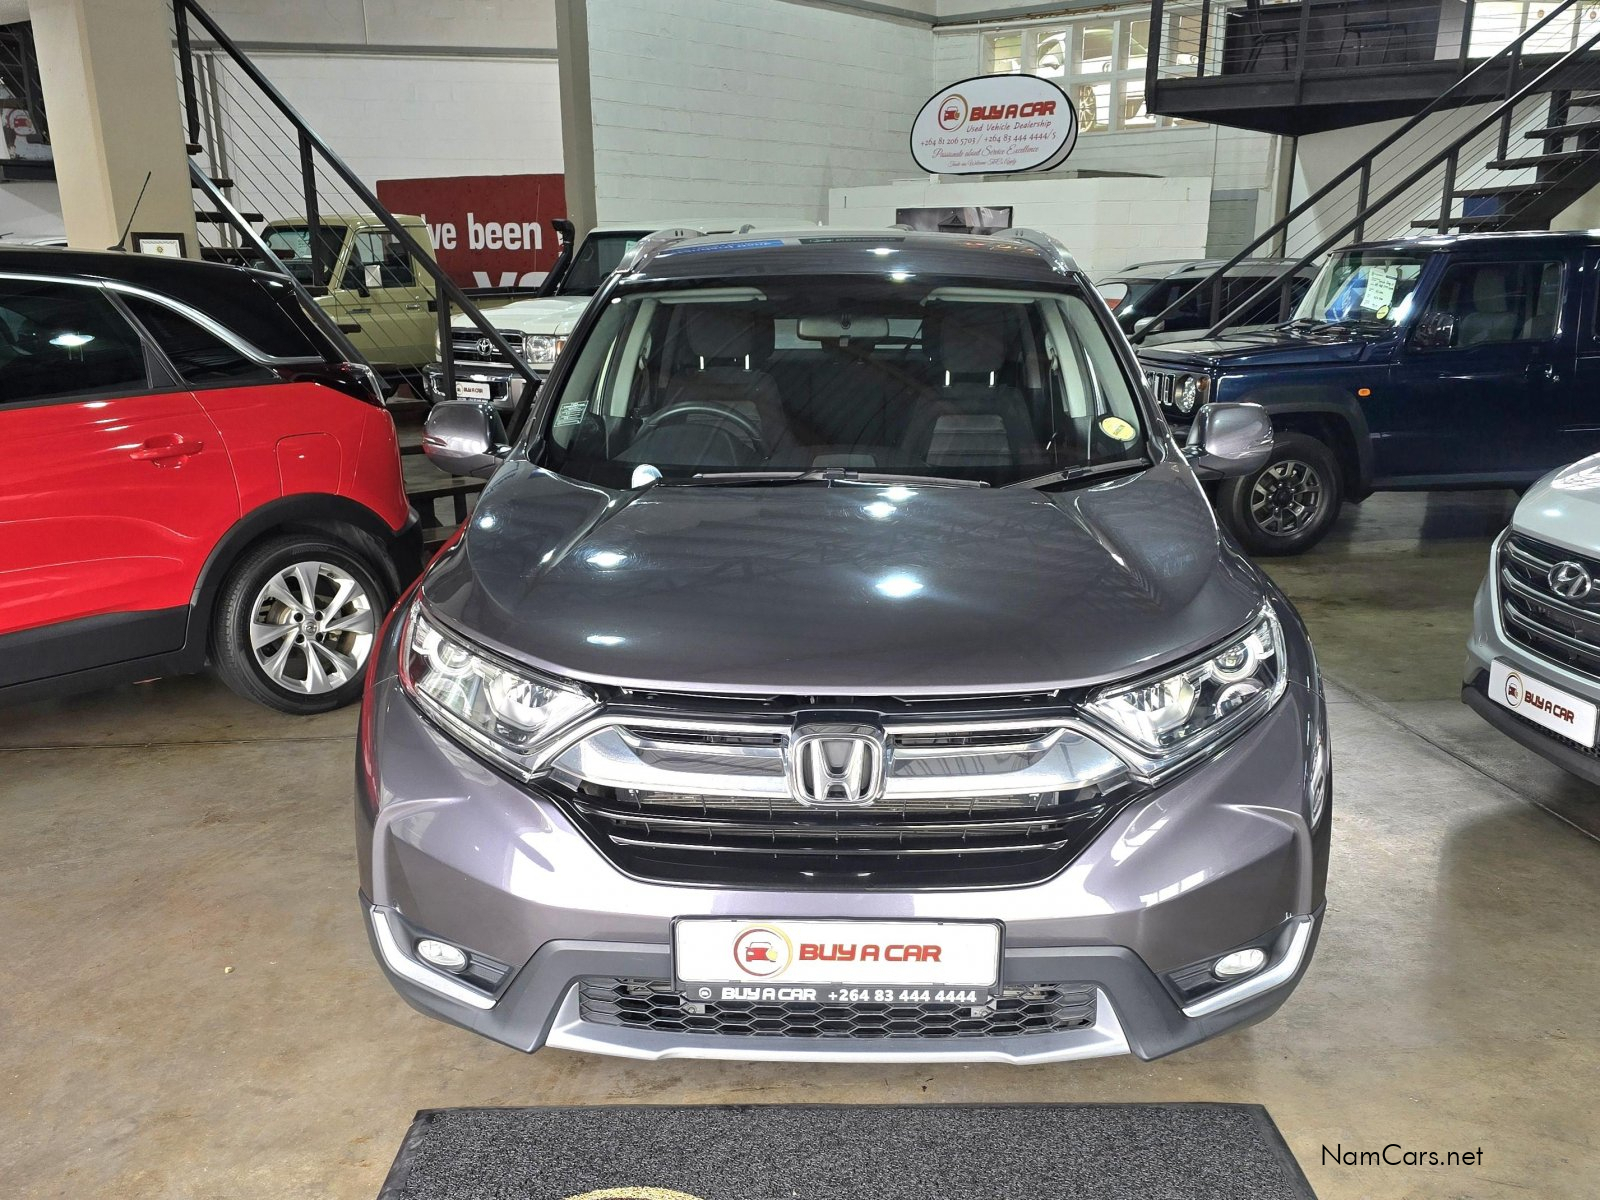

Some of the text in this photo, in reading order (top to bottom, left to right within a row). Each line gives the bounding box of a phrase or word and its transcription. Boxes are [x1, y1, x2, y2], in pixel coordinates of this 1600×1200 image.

[969, 101, 1056, 121] BUY A CAR
[966, 120, 1052, 133] Used Vehicle Dealership
[467, 212, 543, 250] been
[1524, 690, 1575, 725] BUY A CAR
[799, 943, 942, 963] BUY A CAR
[721, 987, 977, 1003] BUY A CAR +264 83 444 4444
